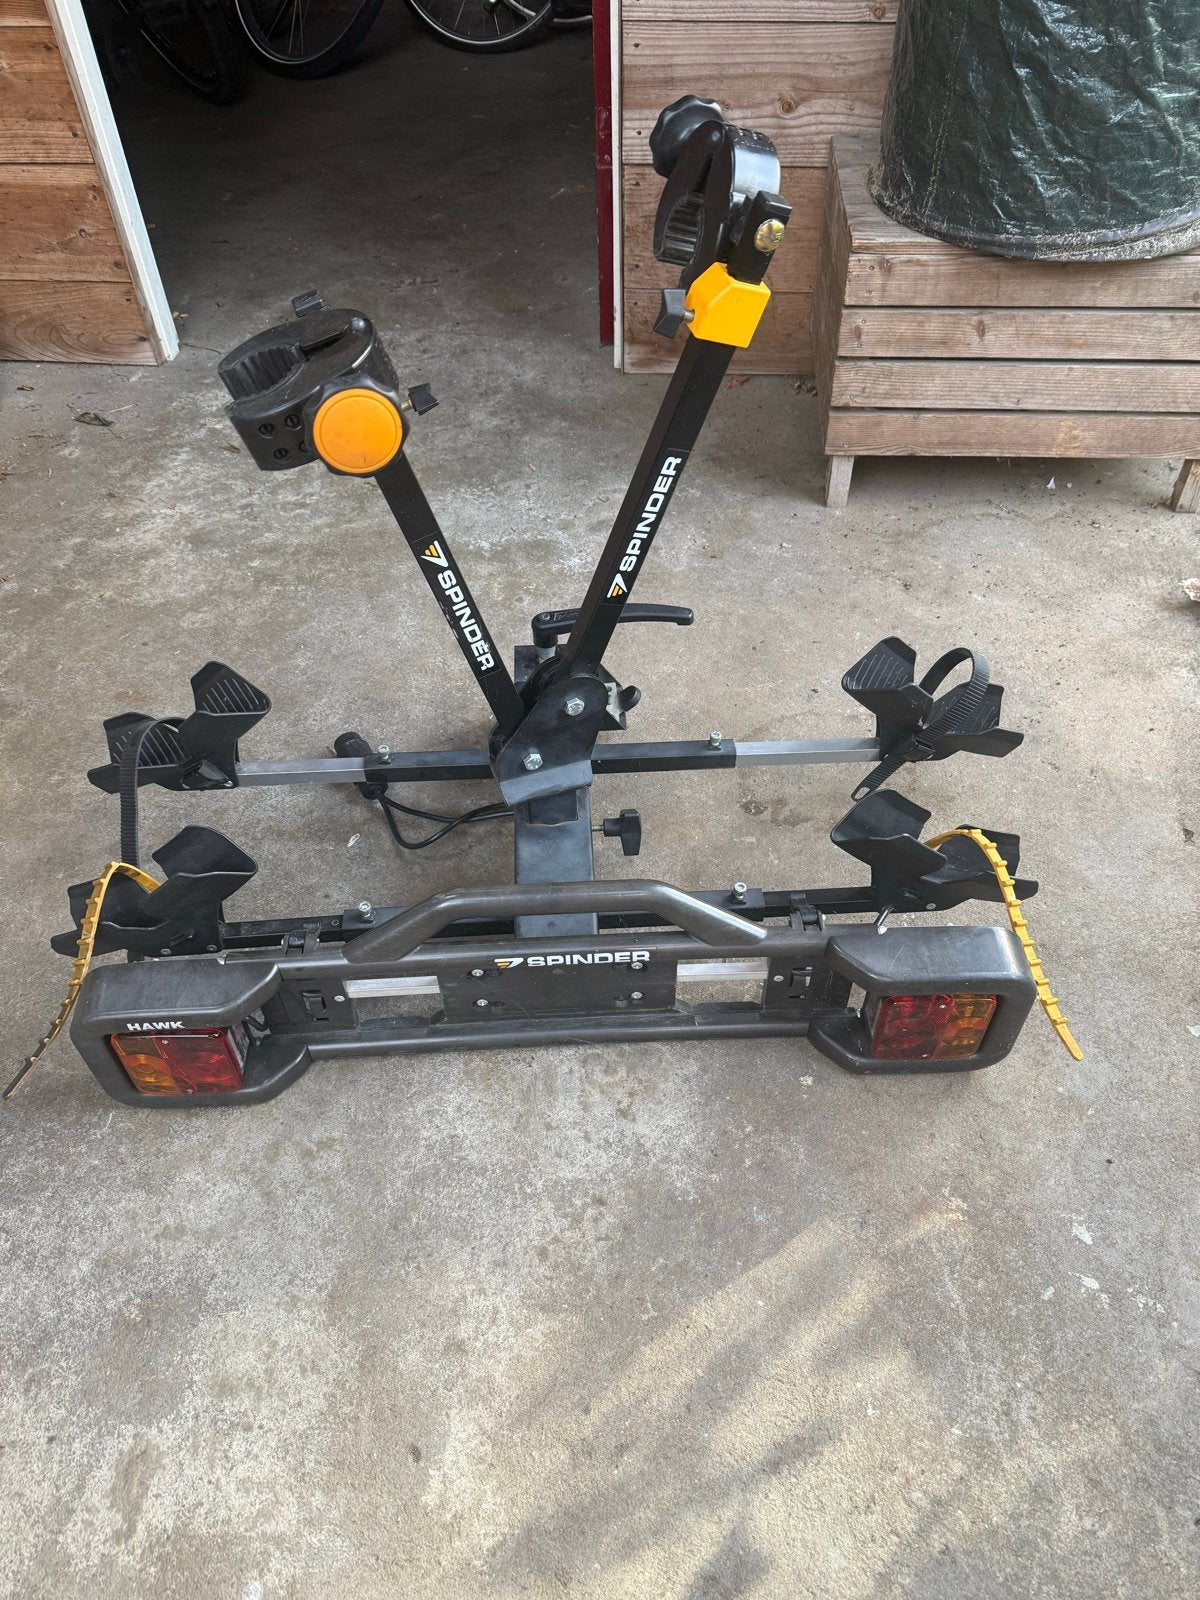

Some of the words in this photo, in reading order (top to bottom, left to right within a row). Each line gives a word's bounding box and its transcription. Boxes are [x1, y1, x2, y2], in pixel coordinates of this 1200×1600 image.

[619, 456, 682, 572] SPINDER
[437, 569, 495, 671] SPINDER
[527, 950, 650, 967] SPINDER
[126, 1020, 186, 1031] HAWK
